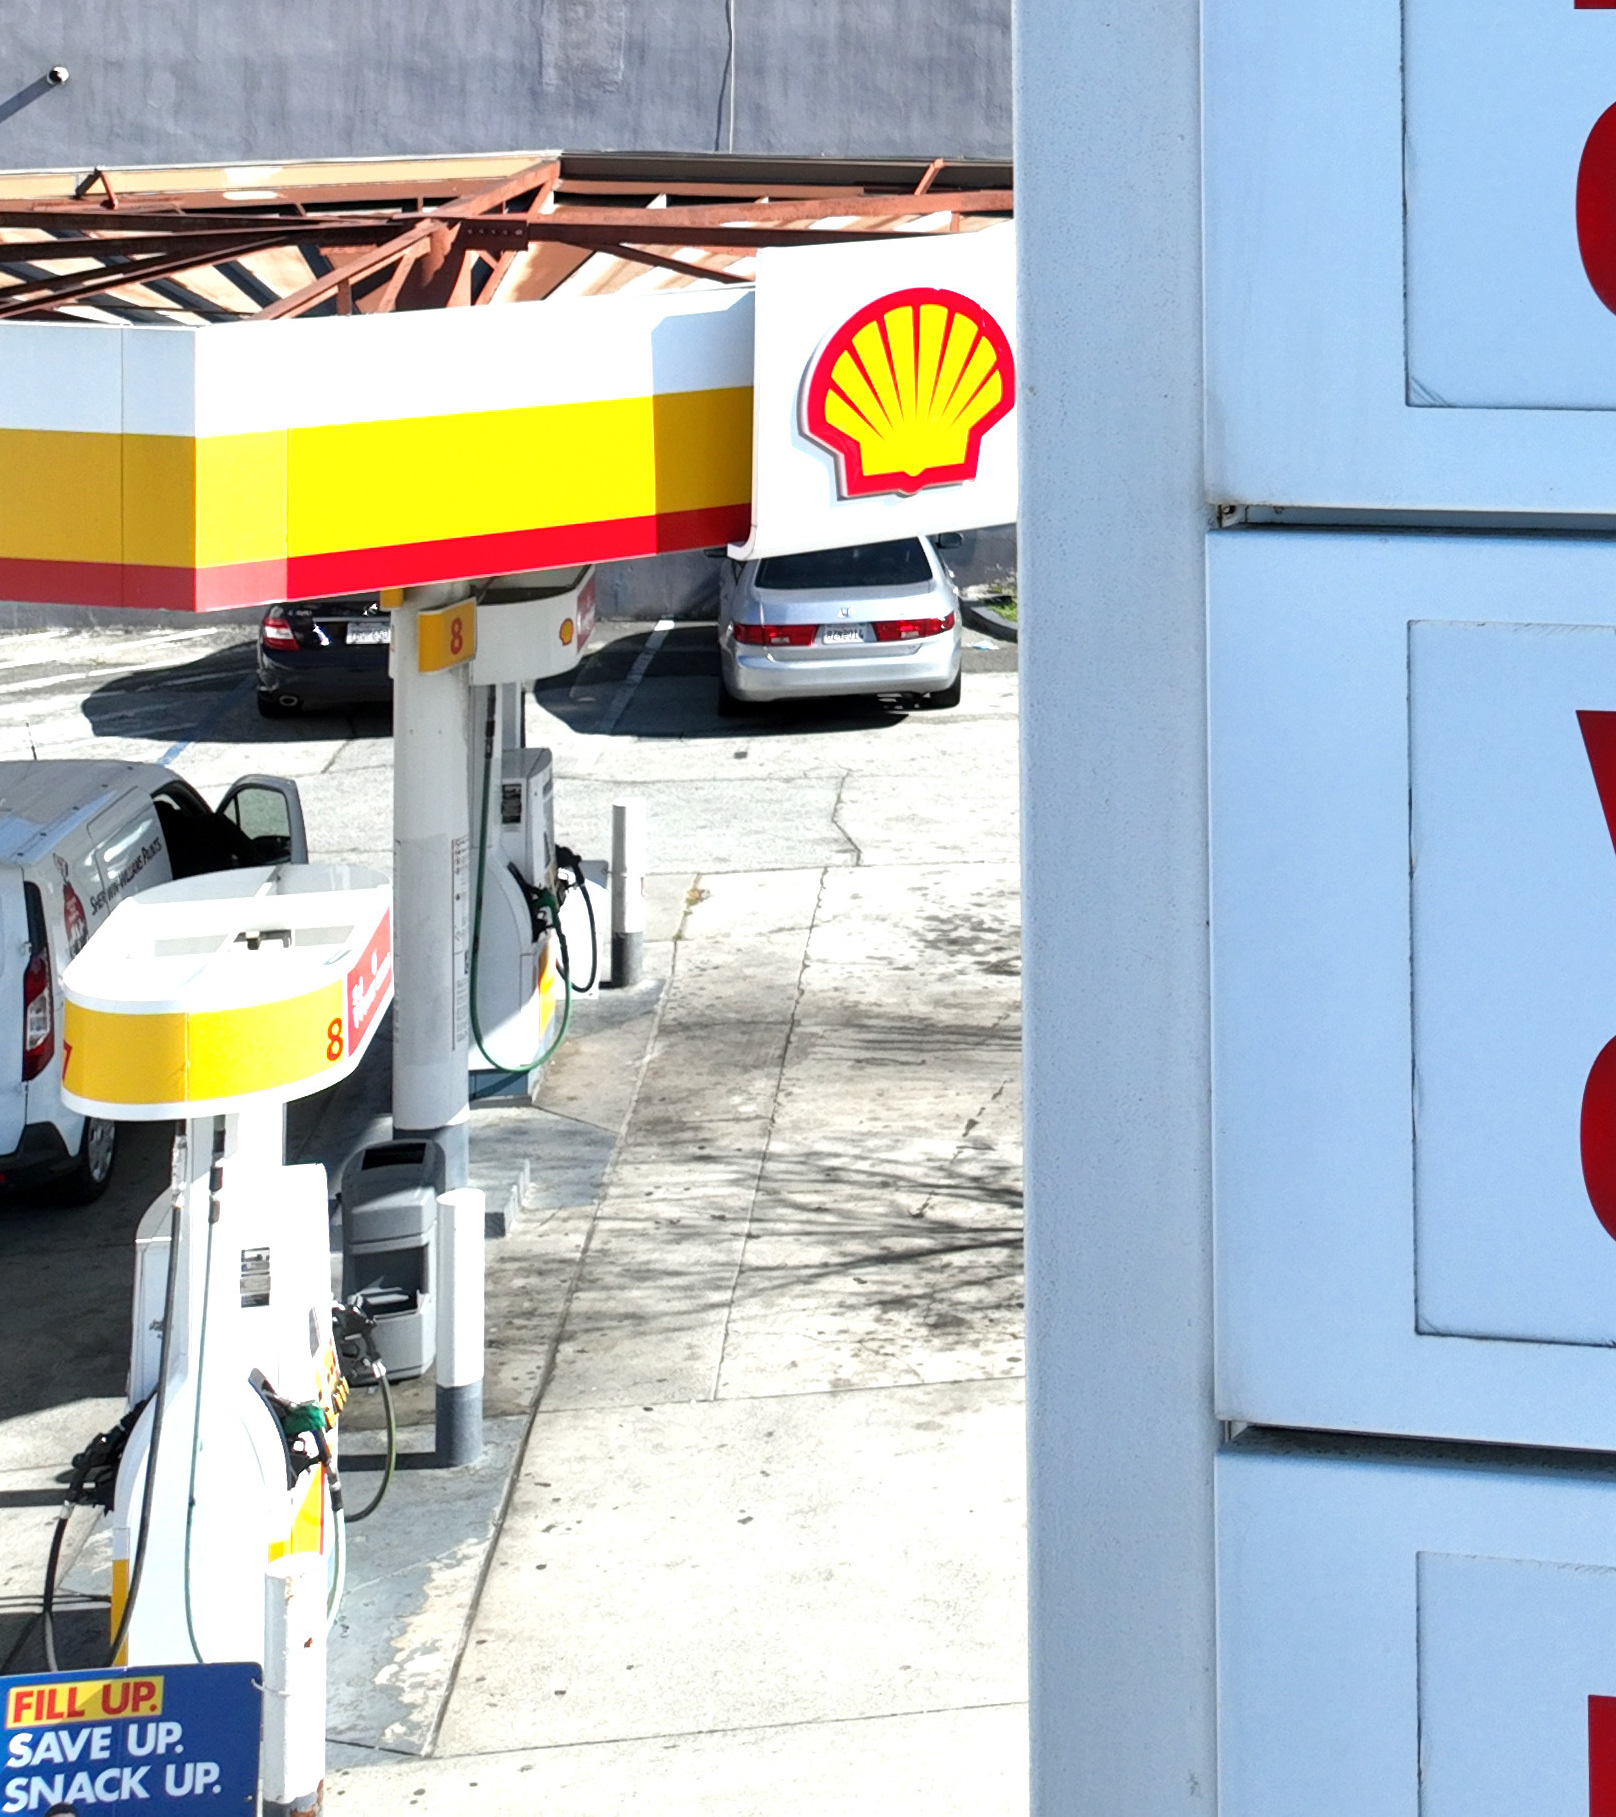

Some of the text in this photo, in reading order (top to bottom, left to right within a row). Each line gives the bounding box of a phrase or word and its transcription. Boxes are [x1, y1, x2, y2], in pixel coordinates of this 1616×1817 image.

[450, 617, 463, 655] 8
[327, 1017, 343, 1061] 8
[13, 1680, 158, 1723] FILL UP.
[5, 1721, 184, 1768] SAVE UP.
[2, 1761, 222, 1813] SNACK UP.
